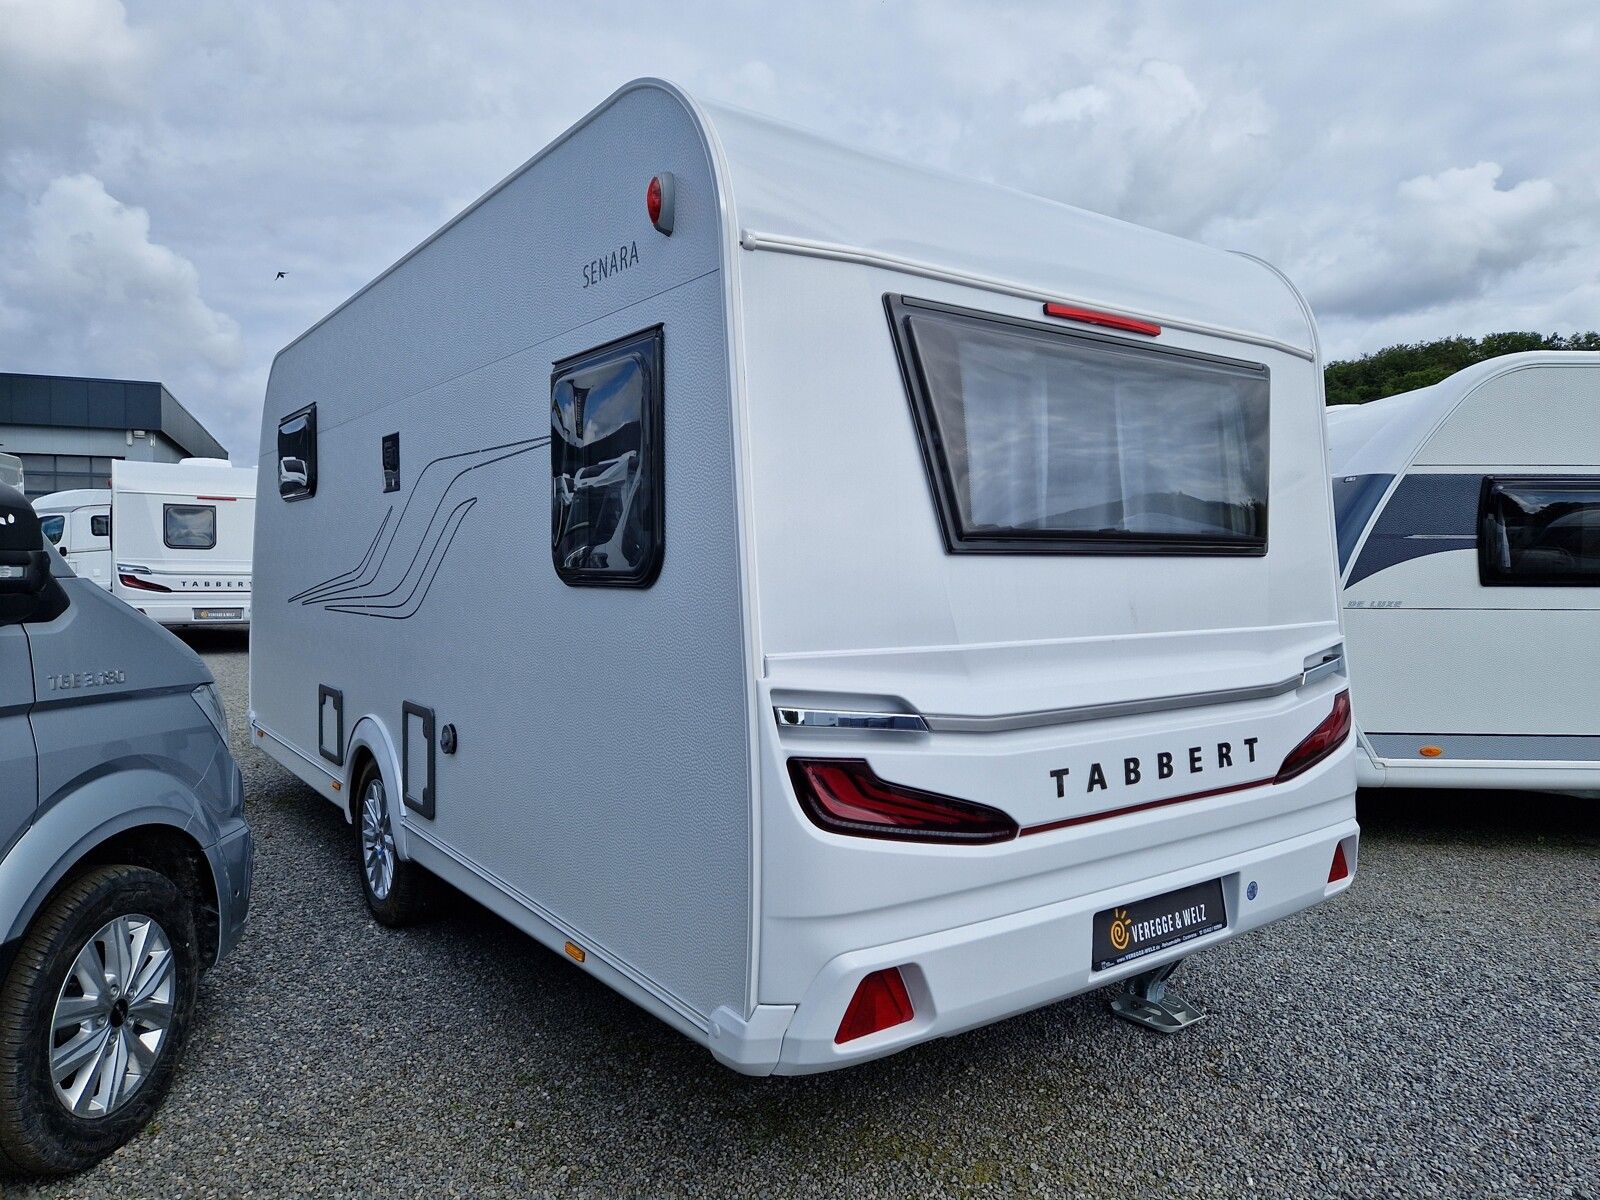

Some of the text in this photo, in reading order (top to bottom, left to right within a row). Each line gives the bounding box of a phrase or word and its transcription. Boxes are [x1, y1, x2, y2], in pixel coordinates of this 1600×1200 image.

[582, 240, 639, 289] SENARA
[1347, 600, 1402, 608] DE LUXE
[1050, 737, 1258, 798] TABBERT
[1131, 914, 1173, 943] VEREGGE
[1175, 911, 1182, 929] &
[1183, 904, 1206, 926] WELZ
